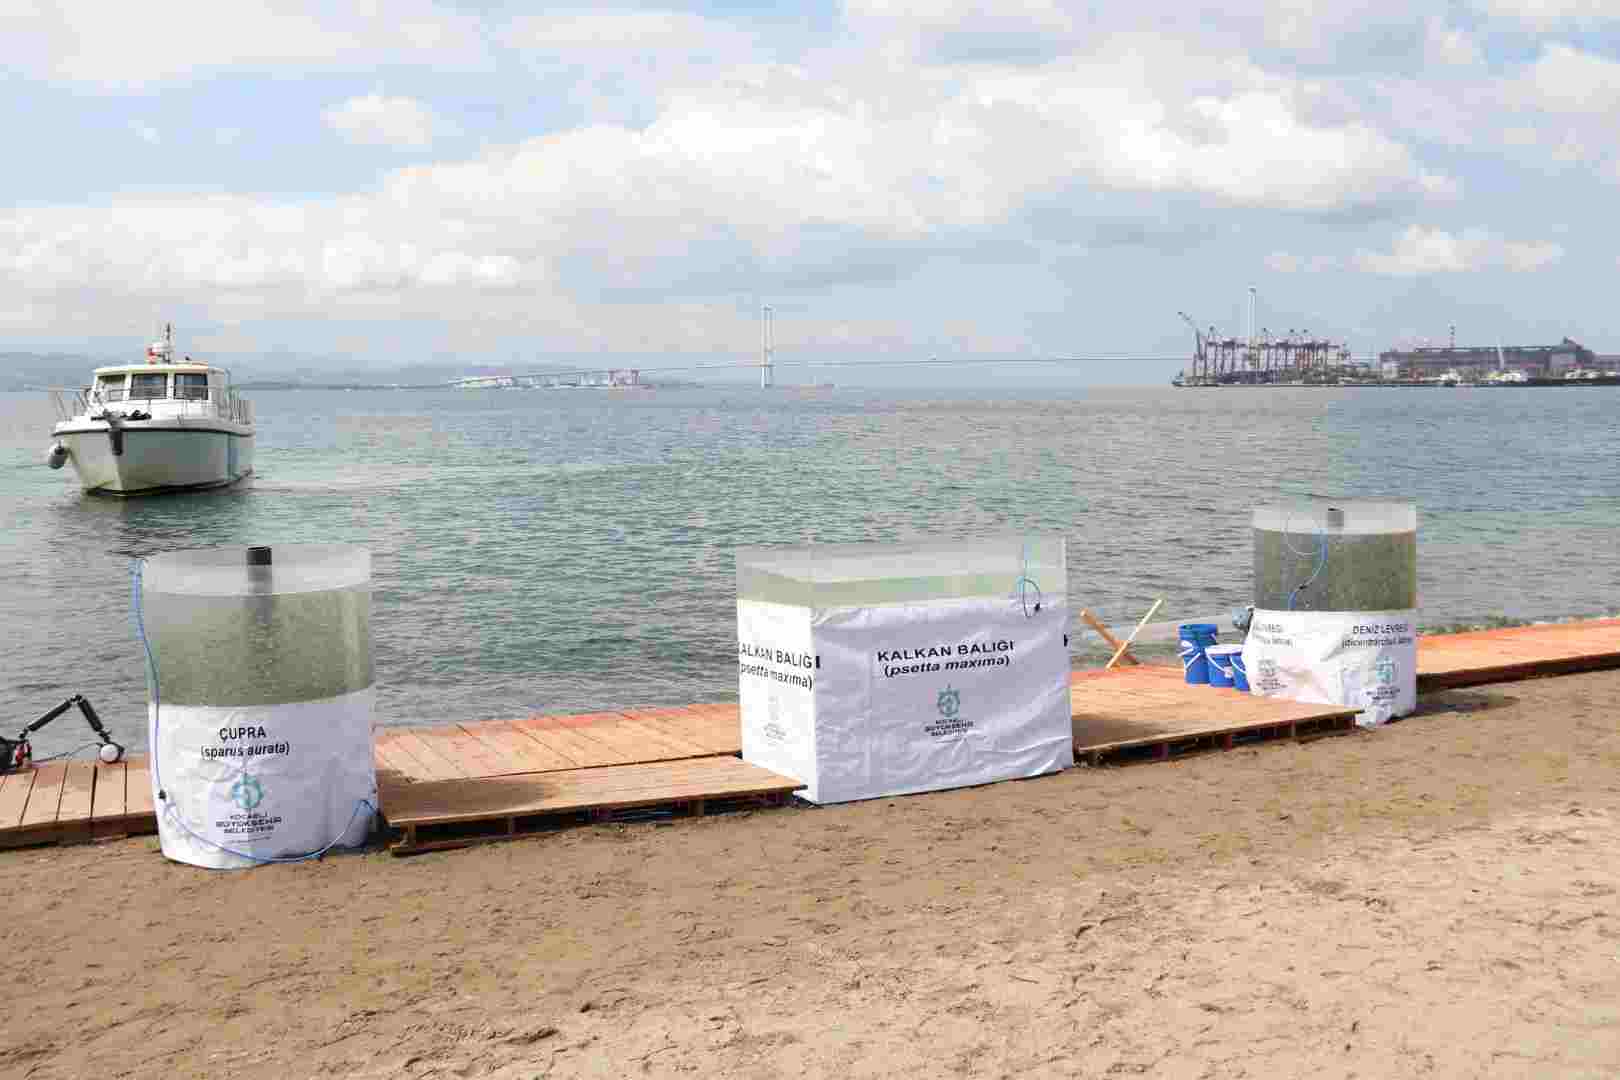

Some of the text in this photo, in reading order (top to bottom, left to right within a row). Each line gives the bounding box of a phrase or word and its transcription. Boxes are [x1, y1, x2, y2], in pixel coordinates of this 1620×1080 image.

[739, 642, 773, 661] ALKAN
[877, 646, 952, 662] KALKAN
[884, 655, 1010, 678] (psetta maxima)
[219, 726, 267, 743] ÇUPRA
[200, 741, 290, 760] (sparus aurata)
